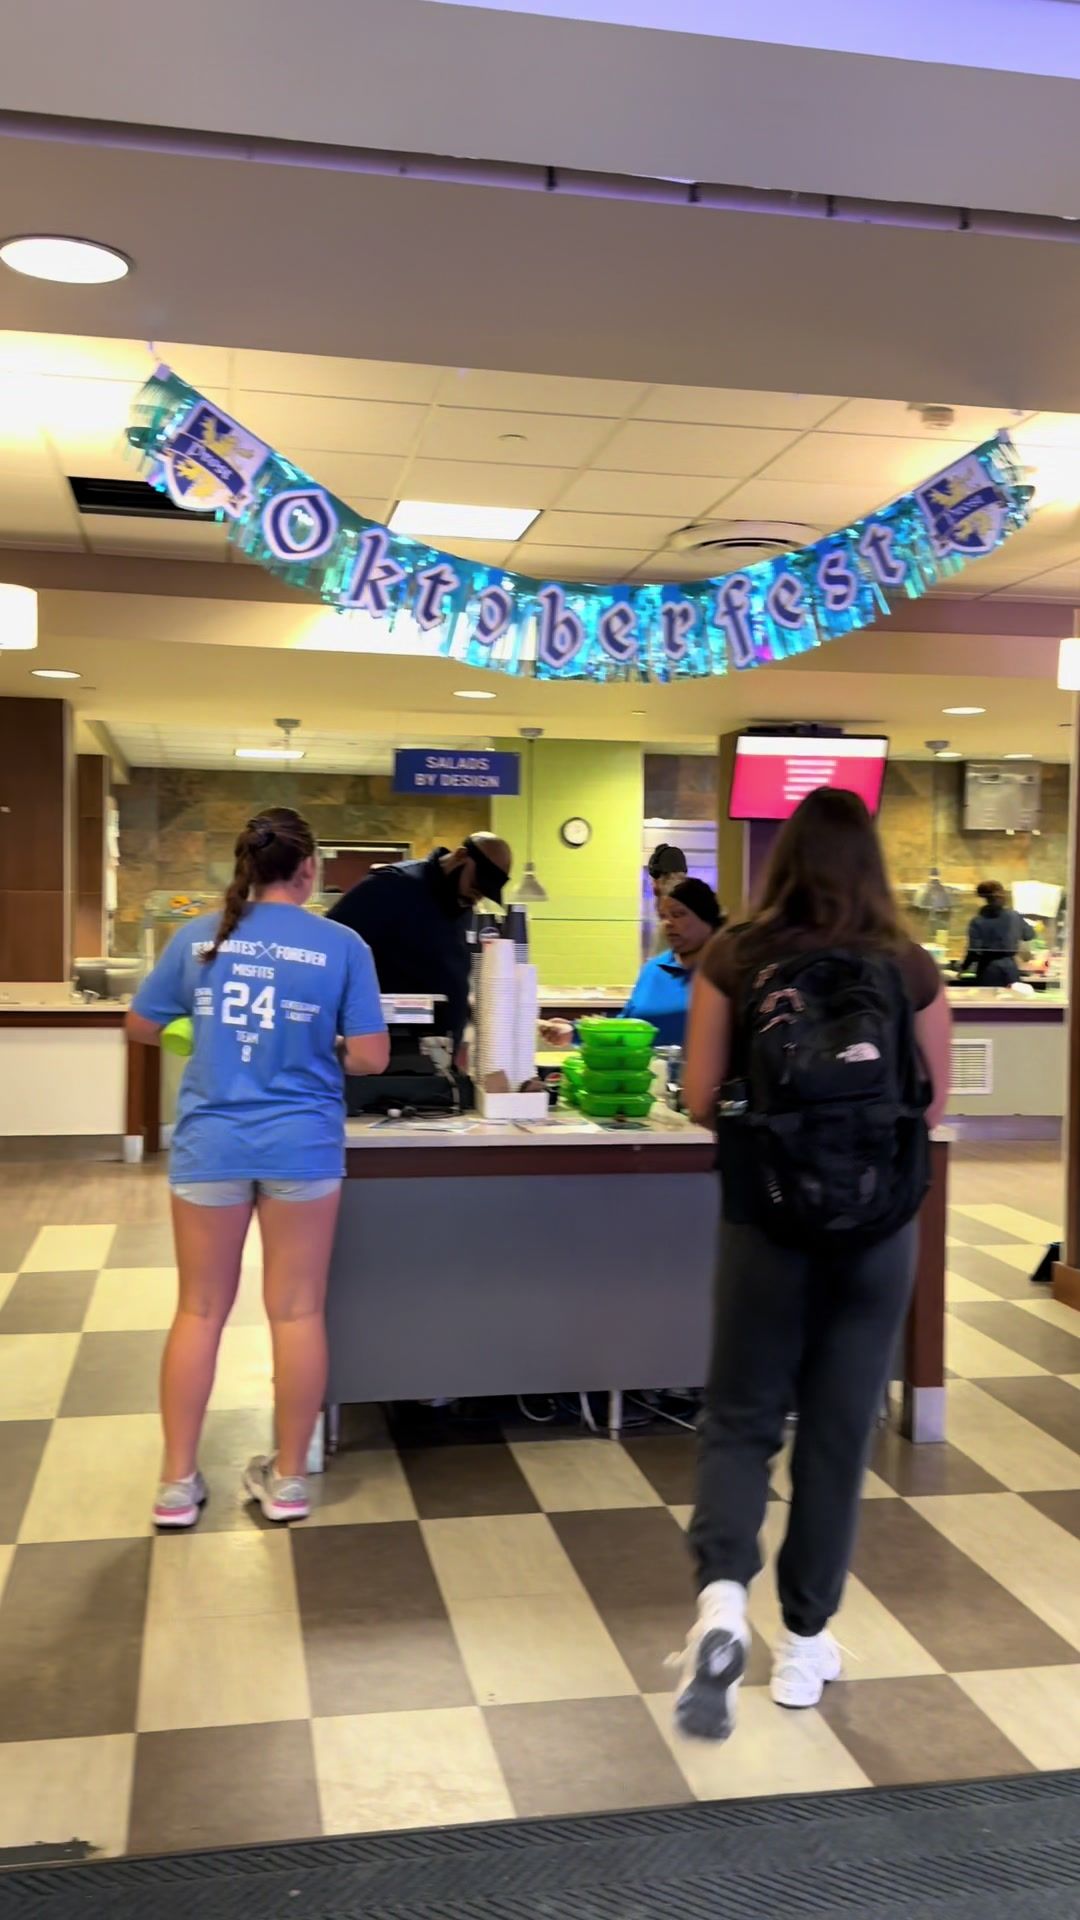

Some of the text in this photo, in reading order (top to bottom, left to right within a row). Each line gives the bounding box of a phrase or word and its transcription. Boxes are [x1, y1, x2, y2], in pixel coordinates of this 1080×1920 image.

[263, 489, 905, 669] Oktoberfest
[425, 756, 490, 770] SALADS
[415, 773, 500, 787] BY DESIGN
[276, 945, 327, 967] FOREVER
[232, 963, 275, 979] MISFITS
[222, 981, 276, 1029] 24
[236, 1030, 259, 1044] TEAM
